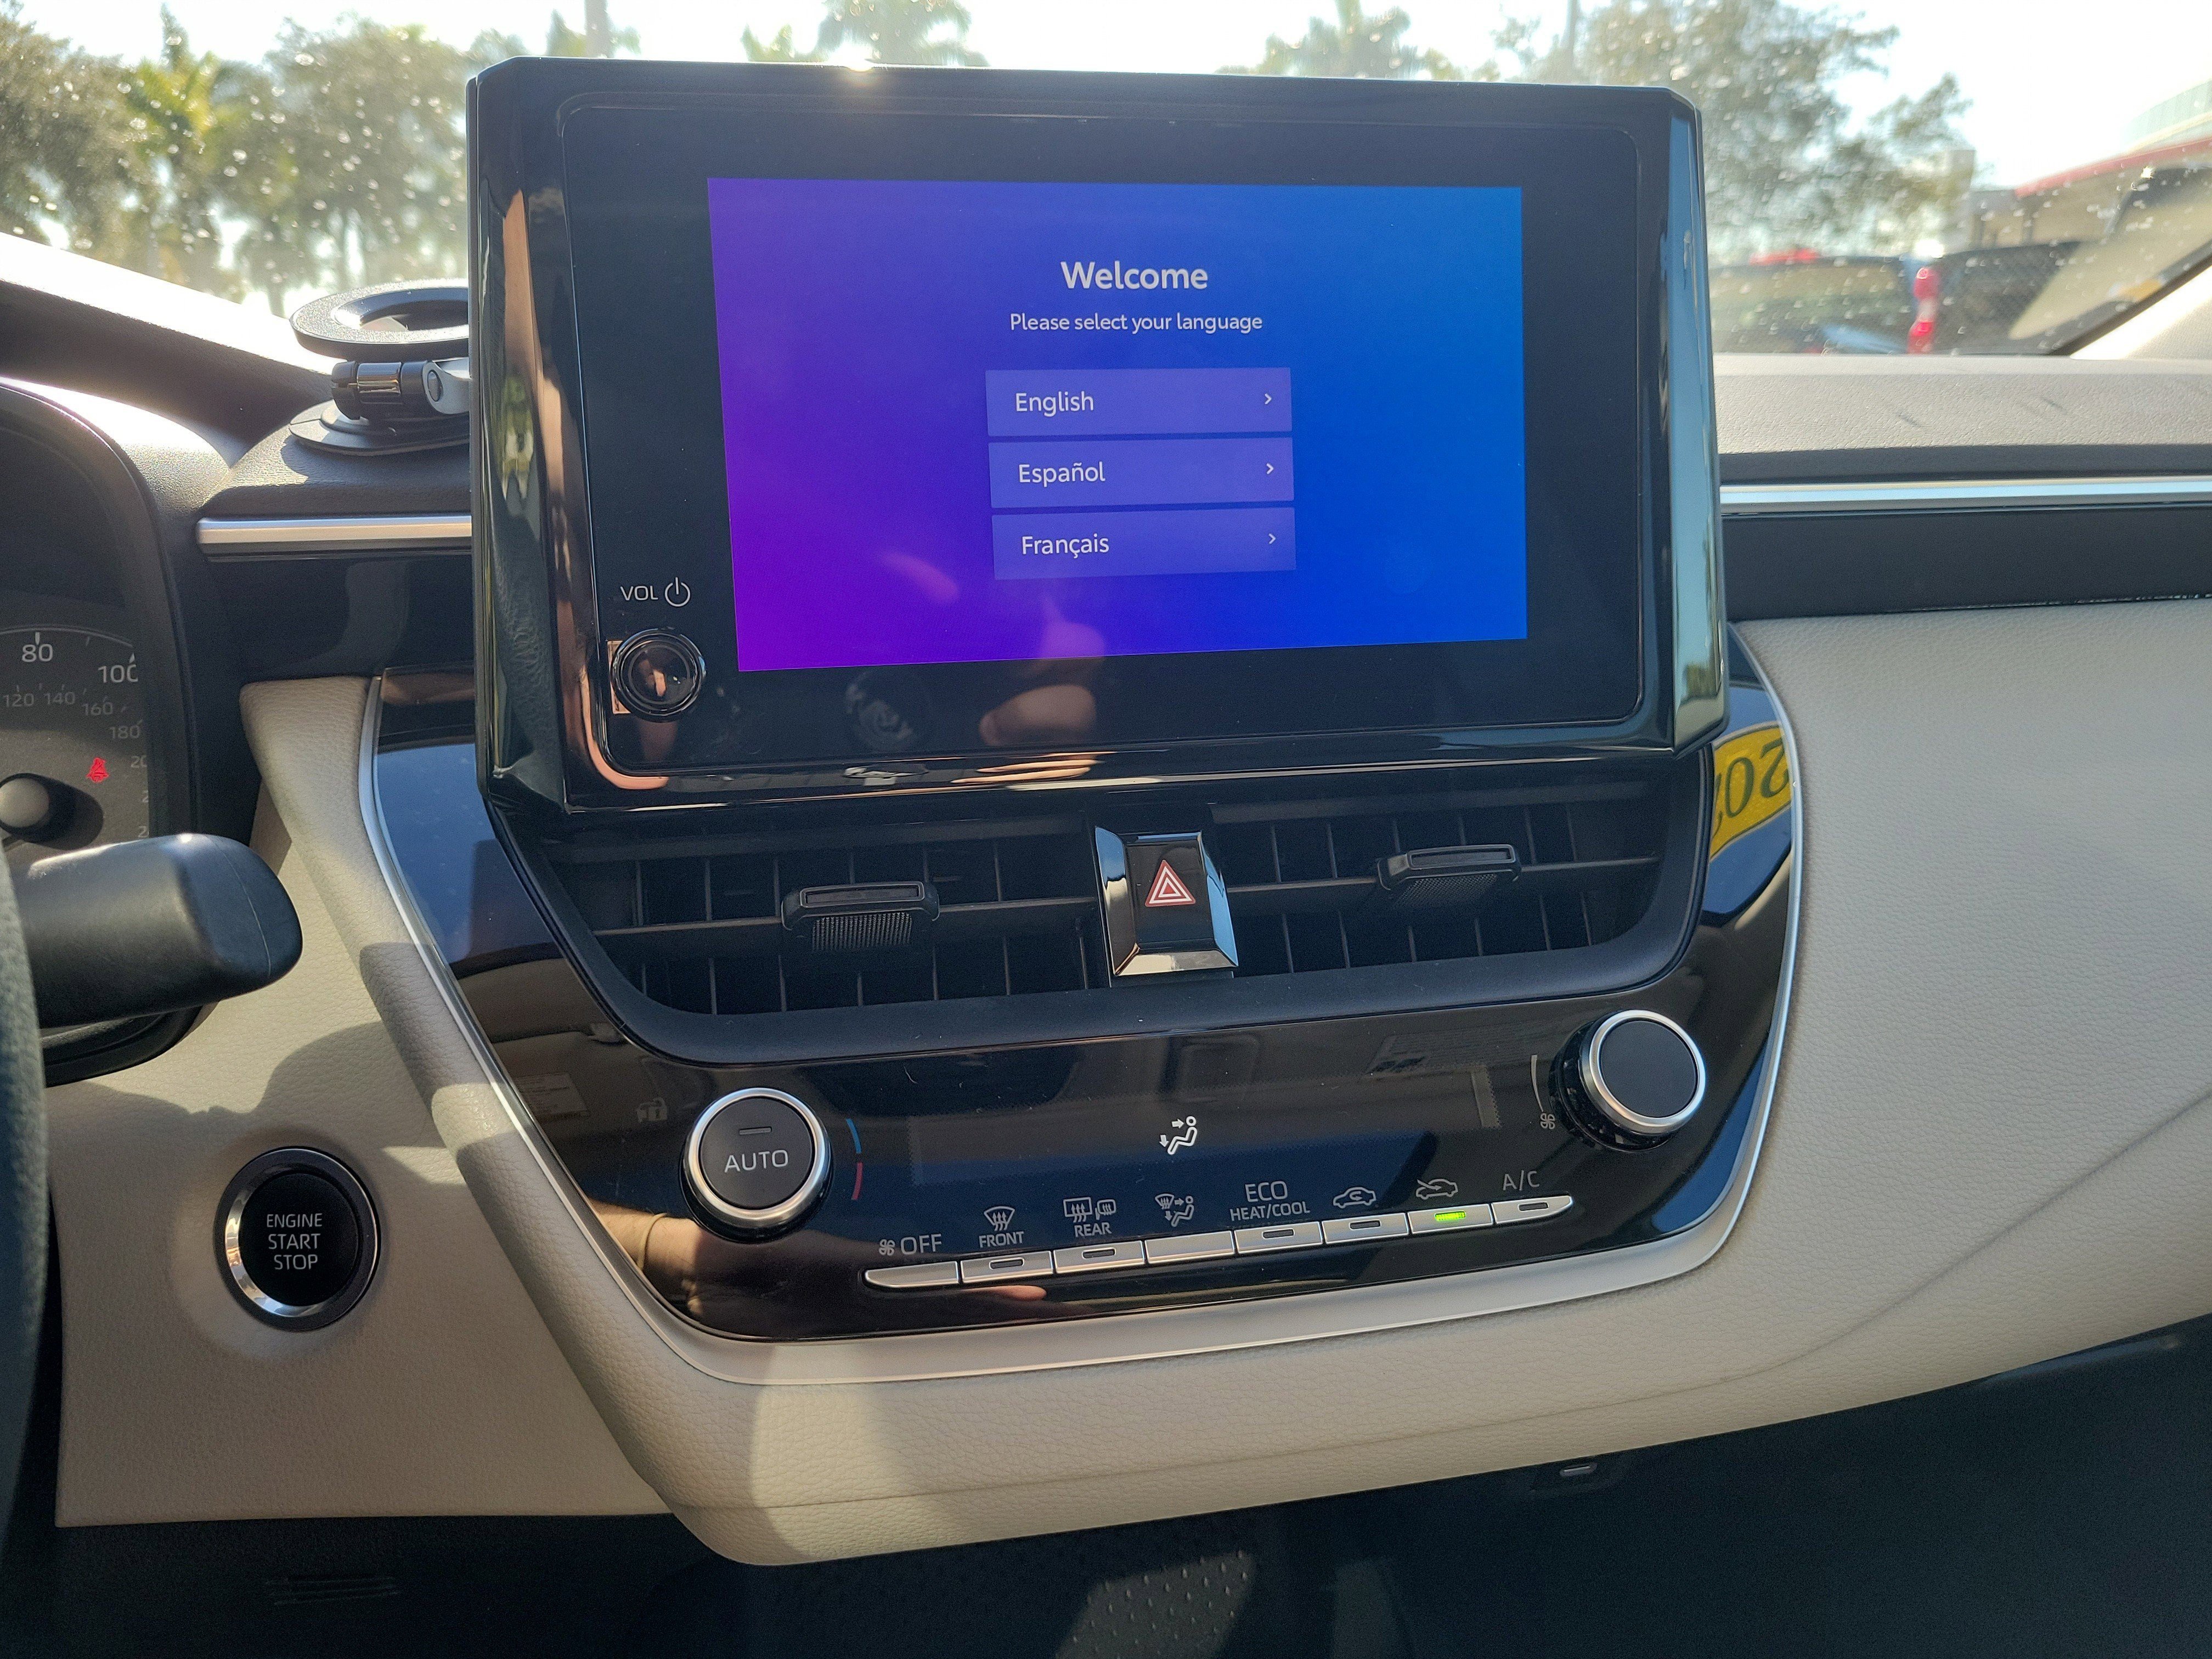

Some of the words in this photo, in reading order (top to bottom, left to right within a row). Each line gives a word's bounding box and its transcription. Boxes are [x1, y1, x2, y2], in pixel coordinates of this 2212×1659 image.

[1060, 261, 1209, 290] Welcome
[1010, 313, 1070, 331] Please
[1074, 313, 1128, 330] select
[1131, 314, 1172, 334] your
[1177, 312, 1262, 334] language
[1015, 391, 1094, 417] English
[1018, 461, 1105, 488] Español
[1022, 533, 1109, 559] Français
[620, 585, 658, 601] VOL
[21, 644, 53, 662] 80
[4, 692, 34, 707] 120
[44, 691, 76, 706] 140
[82, 702, 113, 716] 160
[110, 725, 141, 740] 180
[724, 1149, 789, 1173] AUTO
[1502, 1170, 1540, 1192] A/C
[1244, 1180, 1288, 1203] ECO
[267, 1213, 323, 1228] ENGINE
[1230, 1201, 1311, 1222] HEAT/COOL
[1074, 1221, 1113, 1238] REAR
[268, 1233, 320, 1250] START
[900, 1233, 943, 1256] OFF
[978, 1231, 1024, 1249] FRONT
[274, 1254, 318, 1270] STOP
